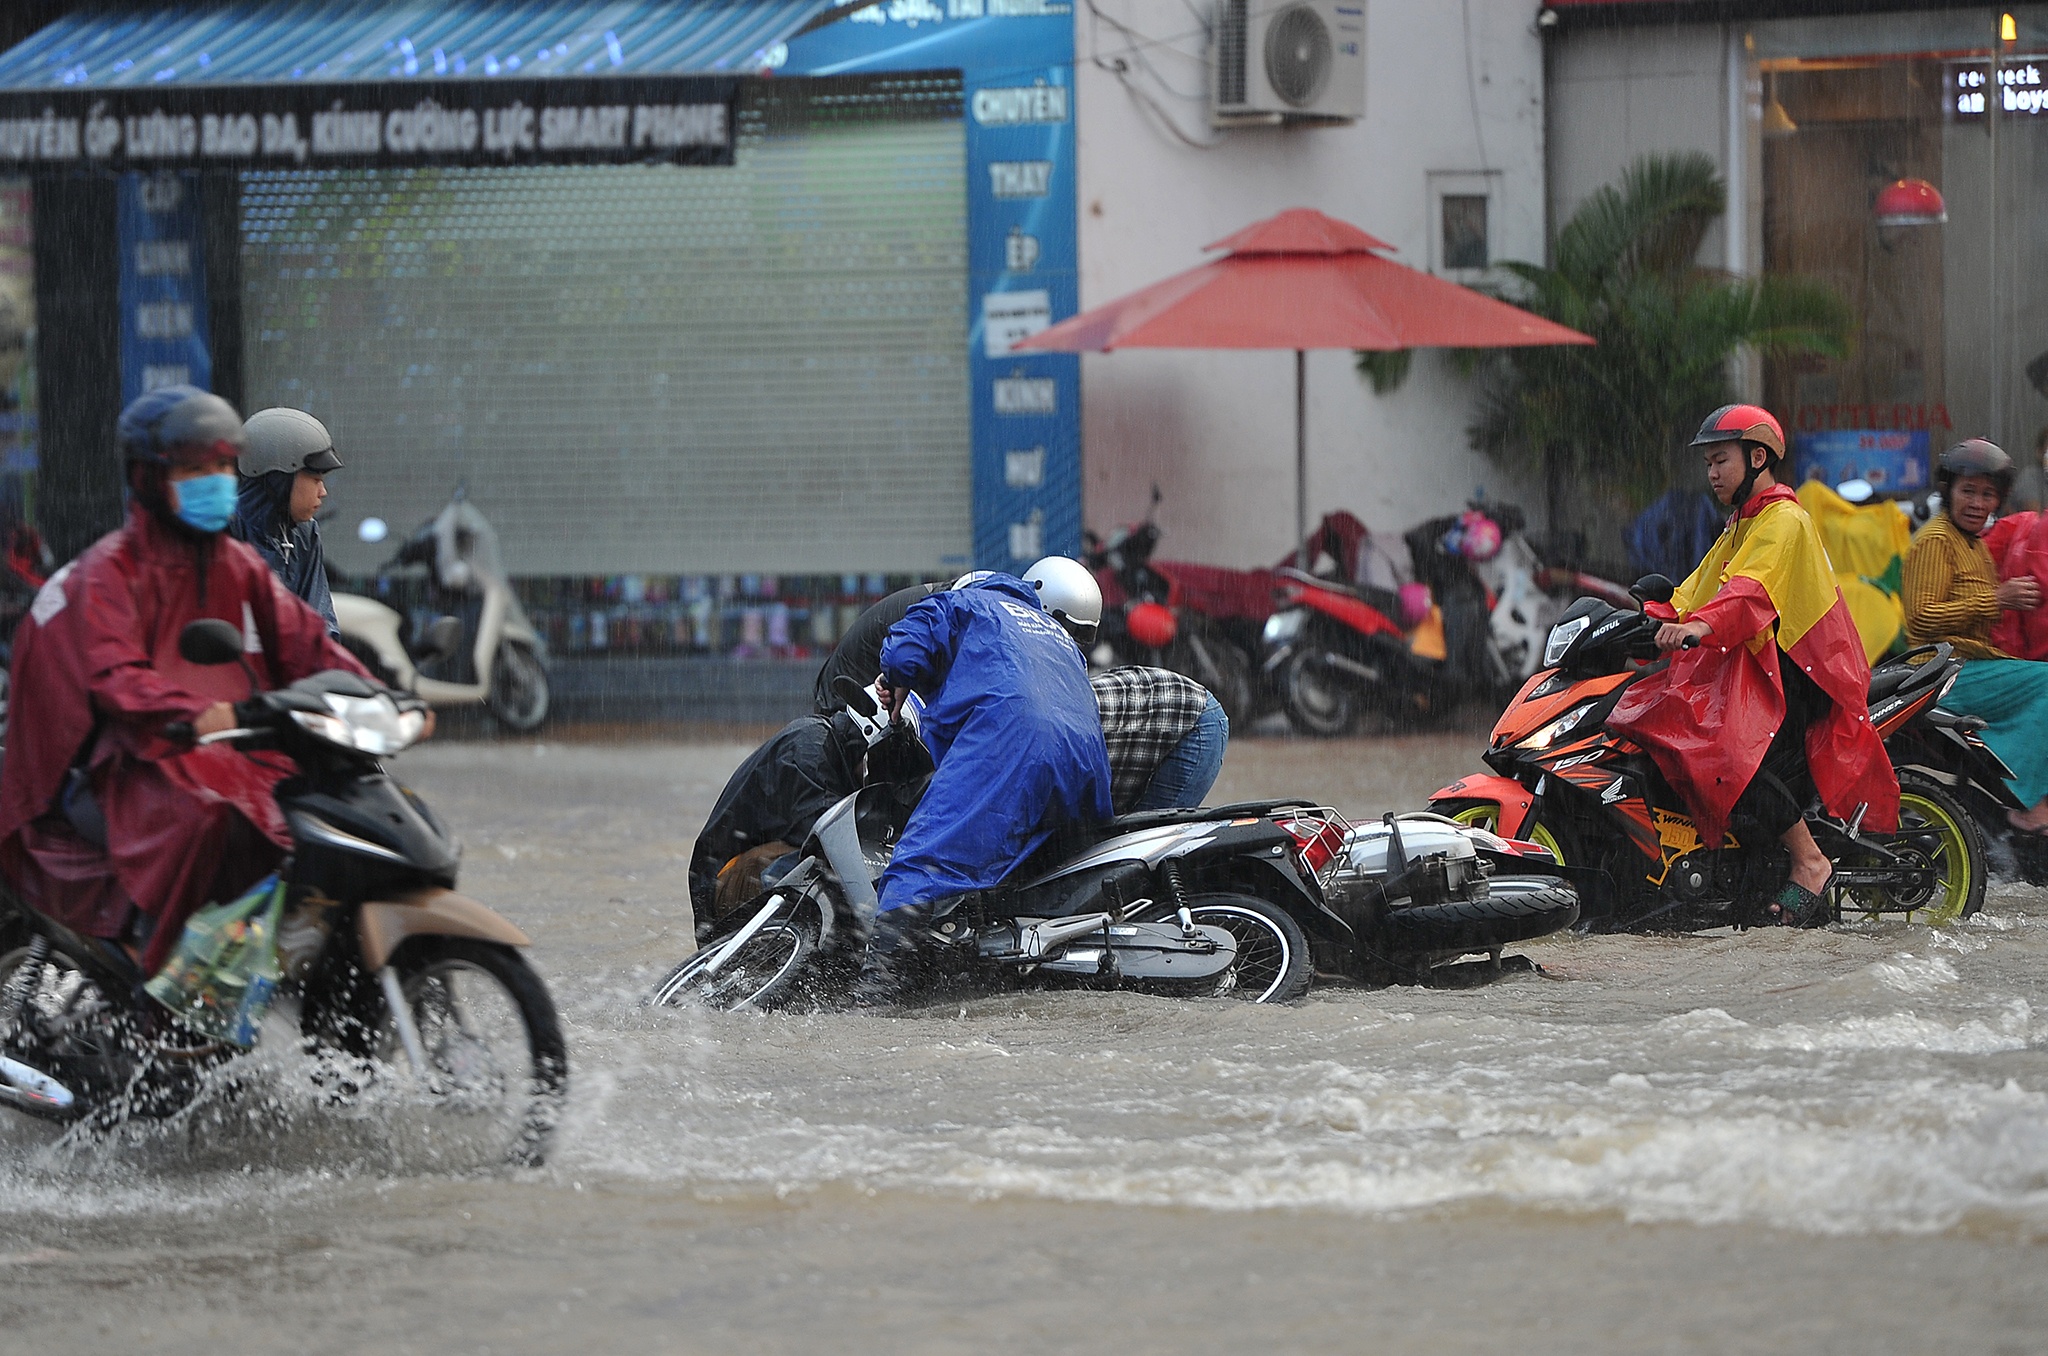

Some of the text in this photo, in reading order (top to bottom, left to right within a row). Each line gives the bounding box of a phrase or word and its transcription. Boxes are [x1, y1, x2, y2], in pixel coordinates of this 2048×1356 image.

[971, 76, 1068, 125] CHUYÊN
[202, 113, 259, 154] BAO
[312, 99, 381, 153] KÍNH
[539, 105, 631, 148] SMART
[632, 103, 726, 147] PHONE
[988, 160, 1053, 198] THAY
[1592, 619, 1620, 639] MOTUL
[1551, 749, 1606, 772] 150
[1602, 793, 1628, 805] HONDA
[1666, 826, 1691, 847] 150
